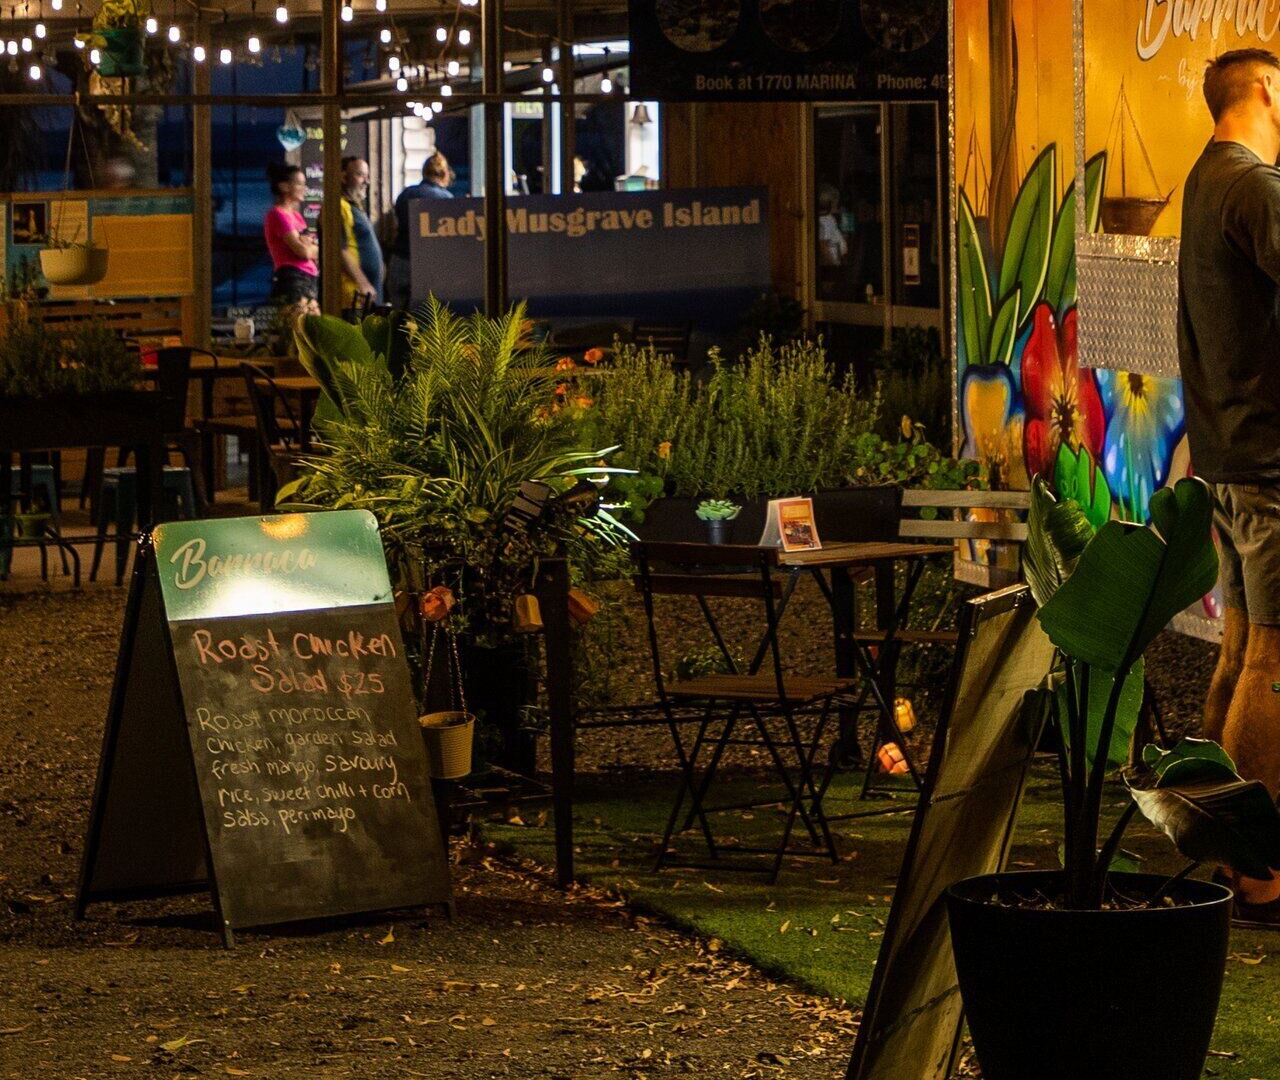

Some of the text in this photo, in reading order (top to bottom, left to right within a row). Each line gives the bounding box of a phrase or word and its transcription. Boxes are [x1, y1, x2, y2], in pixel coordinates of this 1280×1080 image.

[695, 74, 733, 91] Book
[738, 75, 755, 91] at
[757, 74, 793, 91] 1770
[796, 74, 857, 91] MARINA
[877, 74, 928, 90] Phone:
[419, 199, 761, 242] Lady Musgrave Island
[170, 537, 320, 590] Barraca
[193, 628, 281, 664] Roast
[250, 664, 386, 699] Salad $25
[196, 707, 262, 733] Roast
[285, 730, 343, 756] garden
[352, 729, 398, 748] salad
[211, 759, 261, 781] fresh
[262, 785, 311, 803] sweet
